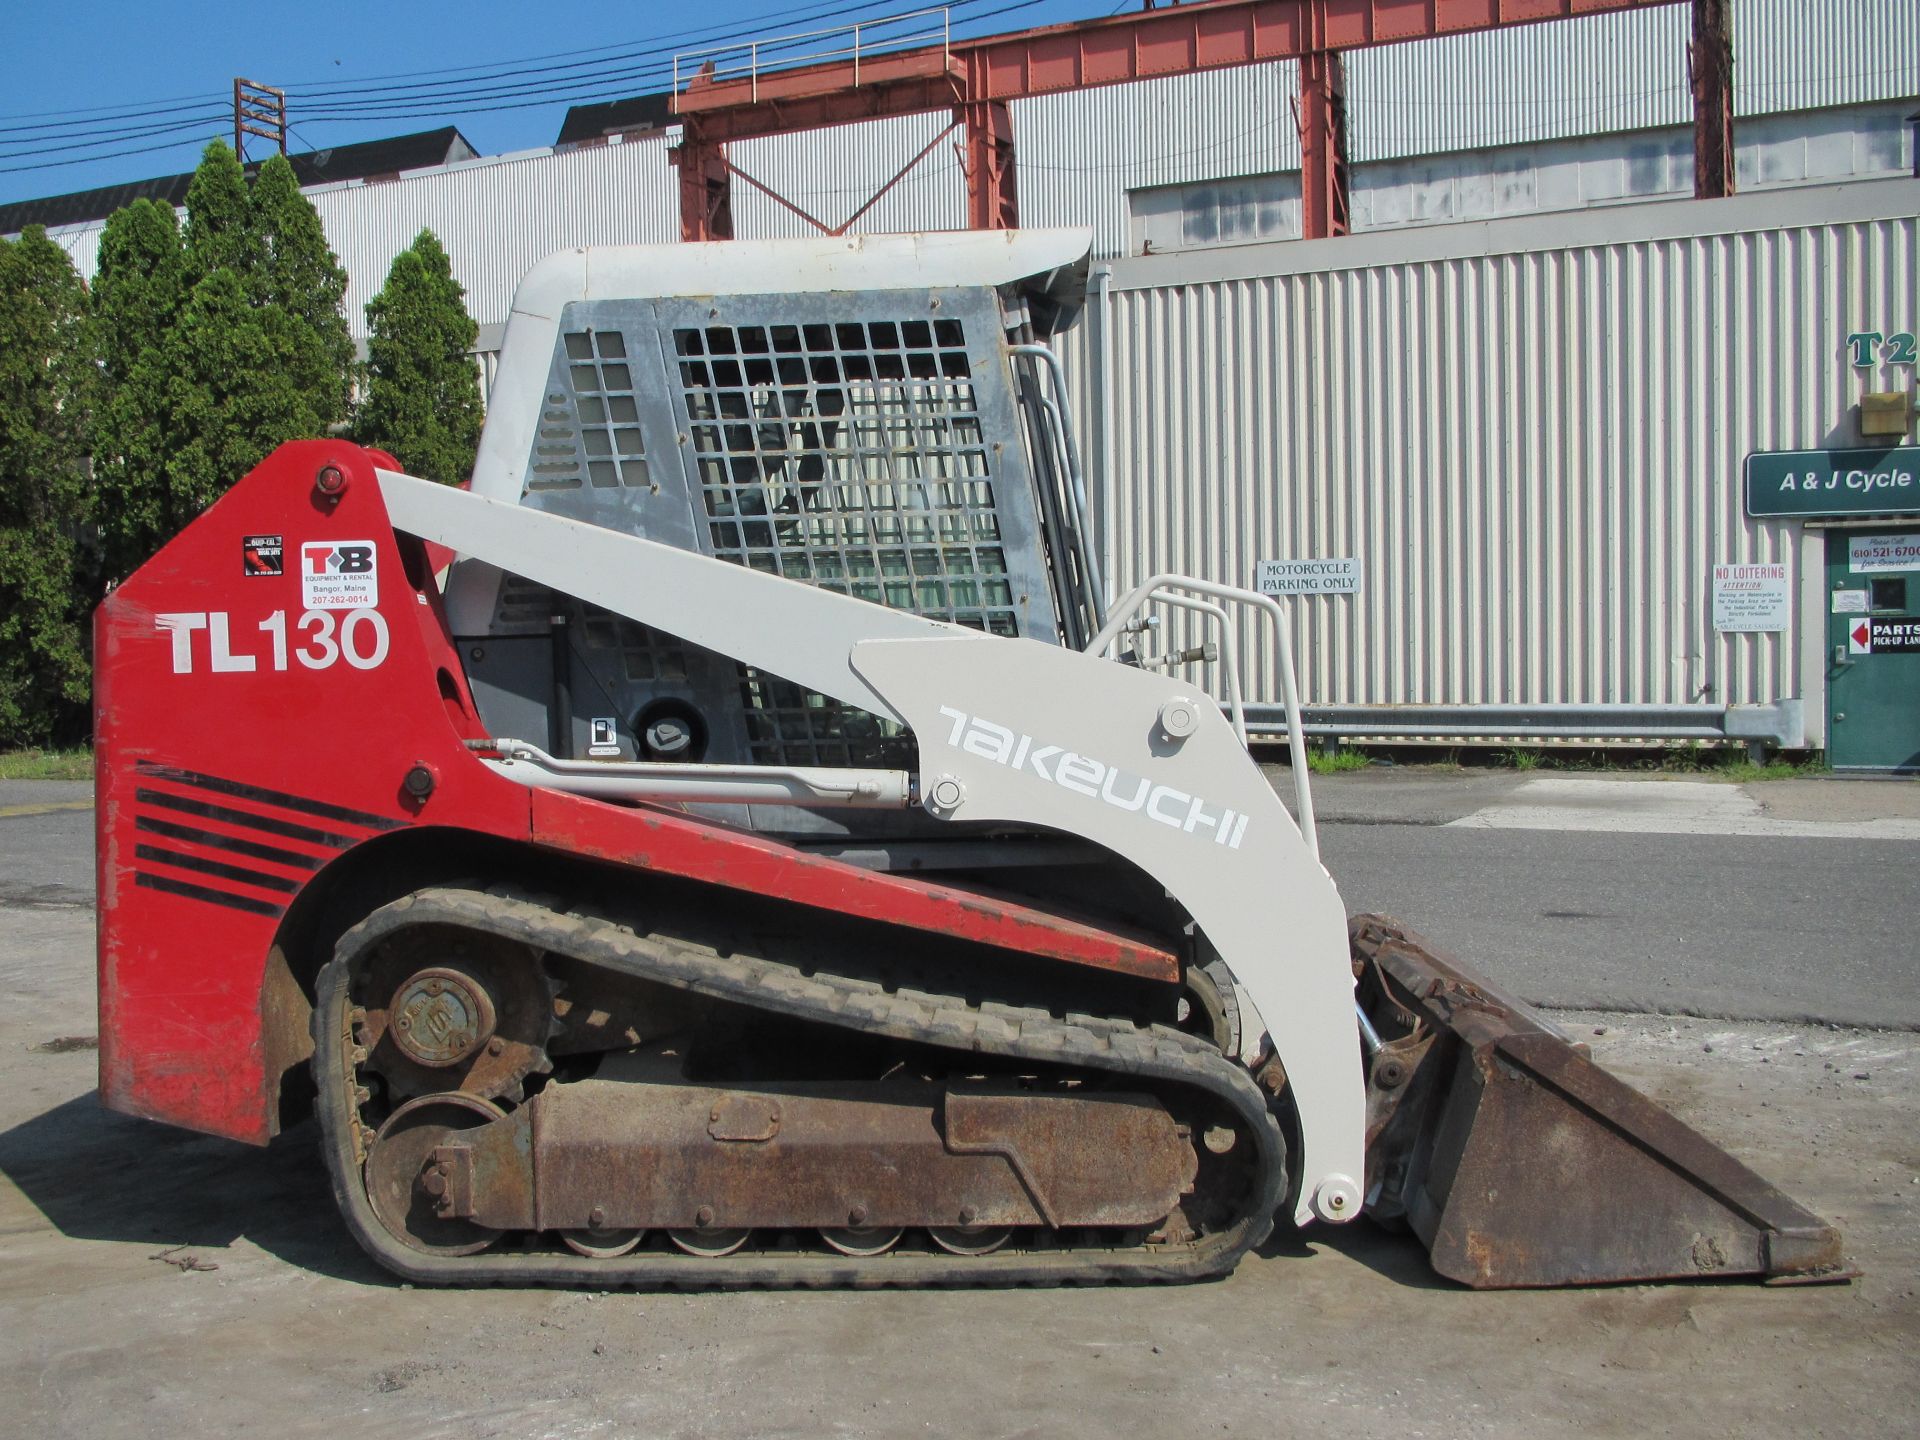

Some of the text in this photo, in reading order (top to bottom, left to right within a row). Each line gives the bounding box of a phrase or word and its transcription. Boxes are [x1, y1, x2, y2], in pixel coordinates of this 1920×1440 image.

[1779, 472, 1796, 491] A
[1802, 472, 1819, 490] &
[1825, 471, 1839, 490] J
[1845, 468, 1911, 493] Cycle
[1266, 563, 1351, 576] MOTORCYCLE
[1861, 560, 1875, 570] for
[1716, 566, 1785, 580] NO LOITERING
[1263, 577, 1356, 590] PARKING ONLY
[312, 595, 368, 604] 207-262-0014
[1873, 624, 1920, 636] PARTS
[1873, 635, 1920, 645] PICK-UP LAN
